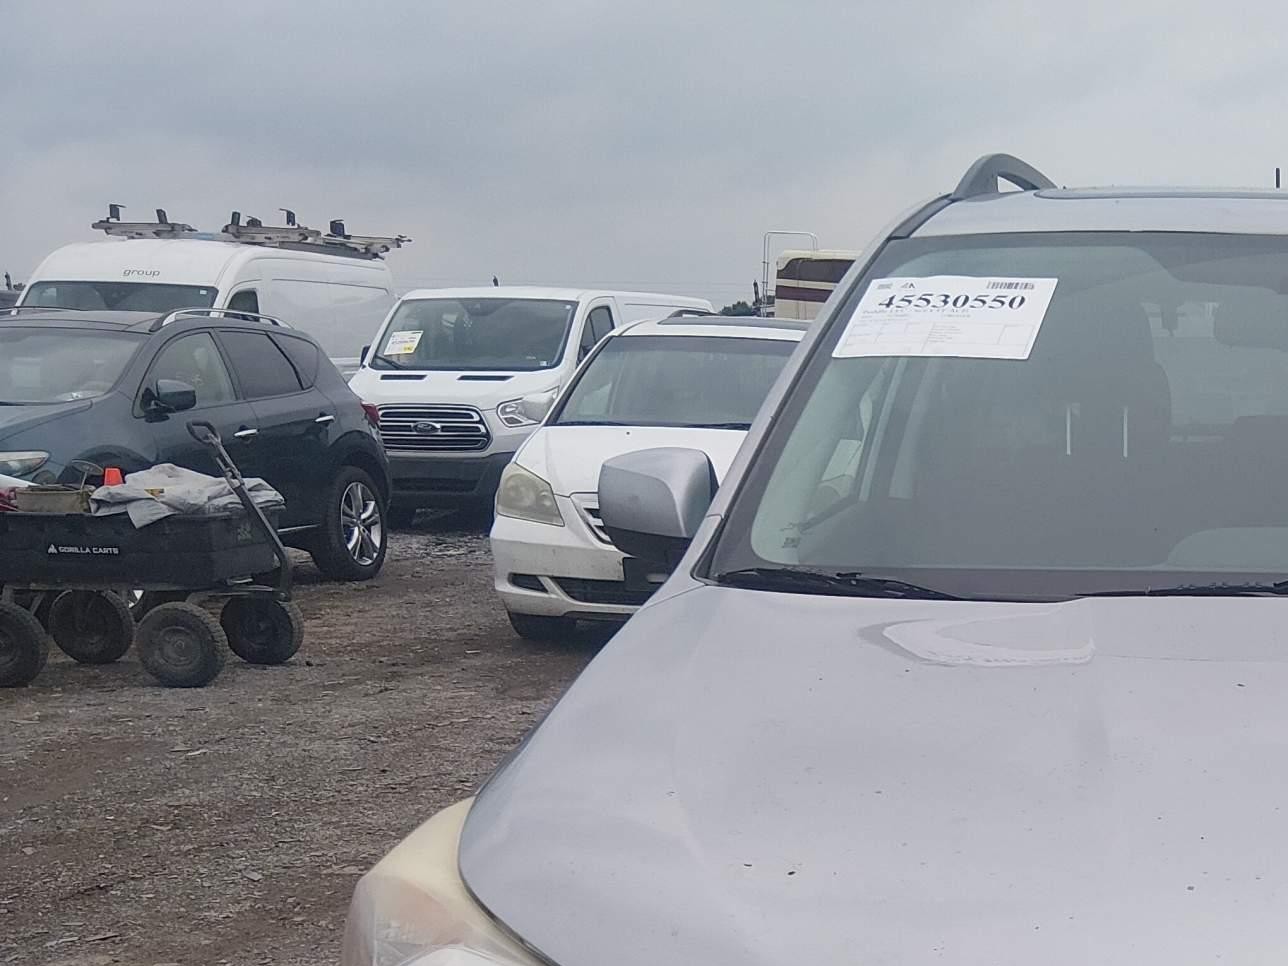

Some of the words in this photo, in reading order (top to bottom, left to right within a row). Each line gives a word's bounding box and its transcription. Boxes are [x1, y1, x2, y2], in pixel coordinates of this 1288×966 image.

[122, 268, 161, 278] group
[878, 293, 1026, 310] 45530550
[58, 546, 92, 554] GORILLA
